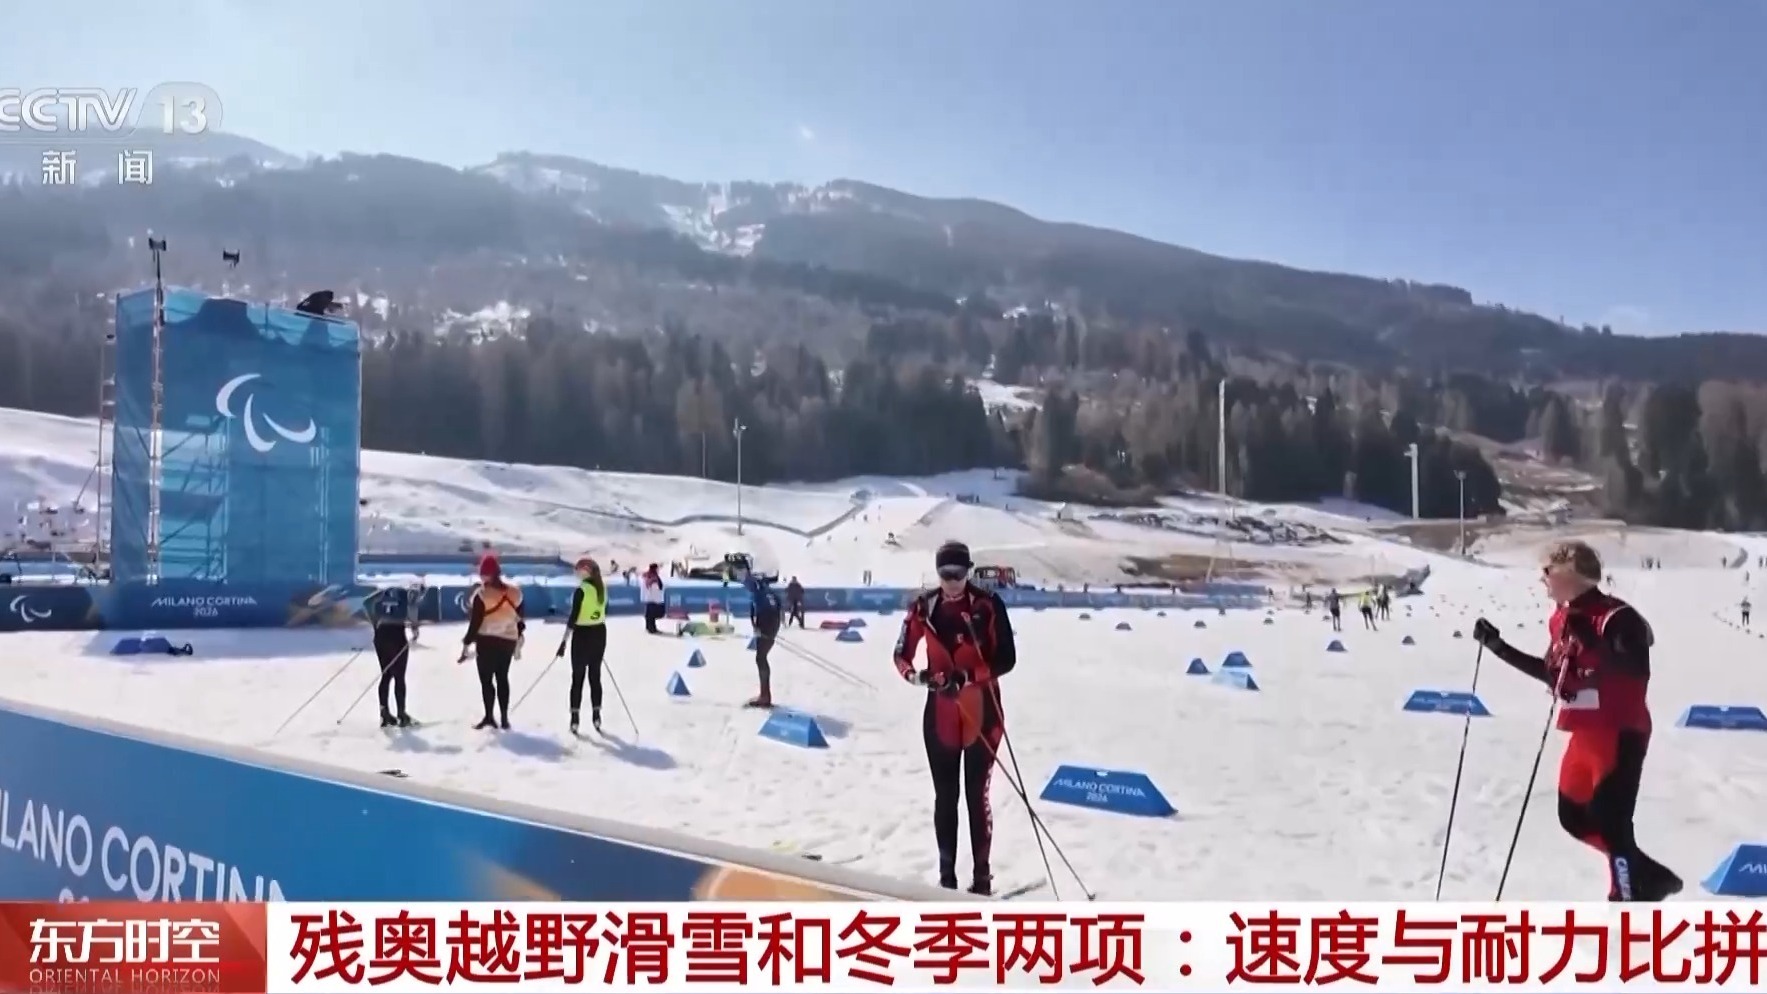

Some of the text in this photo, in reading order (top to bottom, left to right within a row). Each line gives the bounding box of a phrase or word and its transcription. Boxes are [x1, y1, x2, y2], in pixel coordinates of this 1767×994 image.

[152, 596, 258, 607] MILANO CORTINA
[1053, 778, 1097, 792] MILANO
[0, 788, 93, 877] LANO
